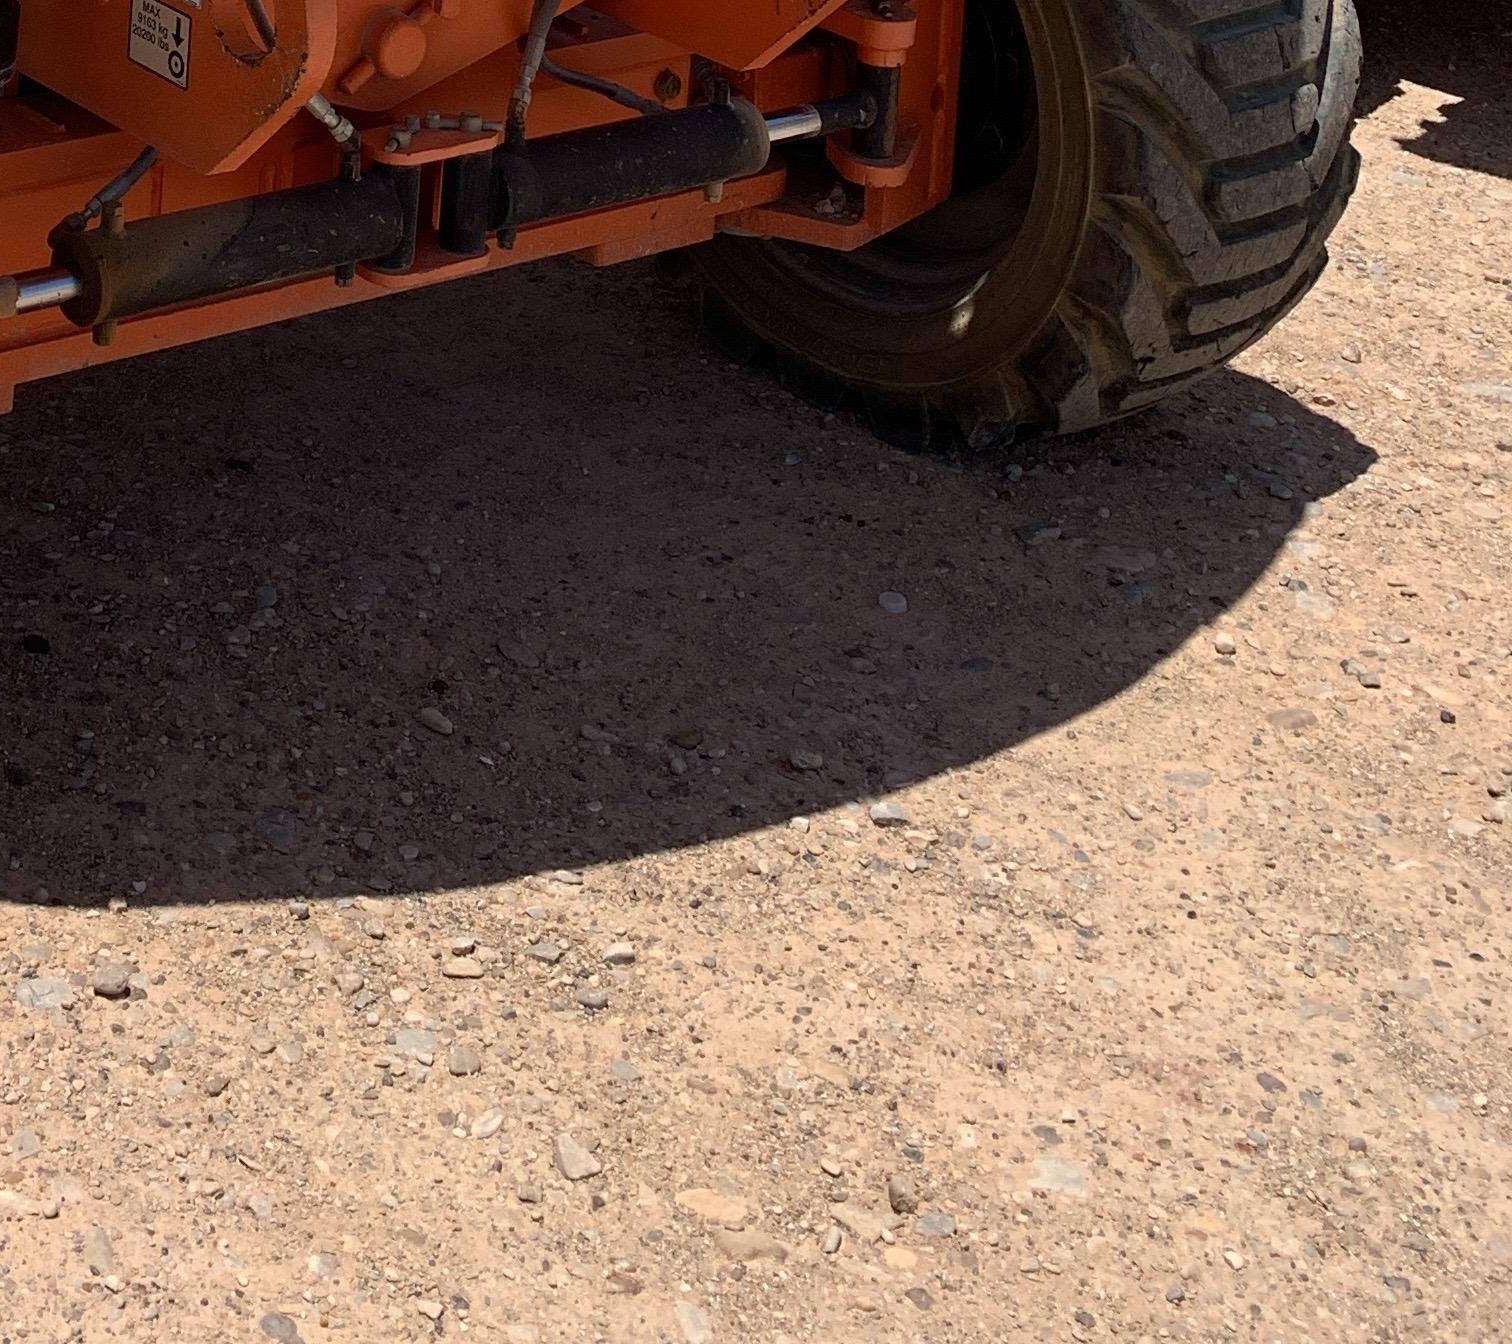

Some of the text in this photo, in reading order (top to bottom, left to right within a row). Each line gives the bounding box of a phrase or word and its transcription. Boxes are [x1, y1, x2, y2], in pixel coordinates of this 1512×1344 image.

[142, 0, 161, 19] MAX
[137, 12, 169, 39] 9163 kg
[157, 34, 170, 52] lbs
